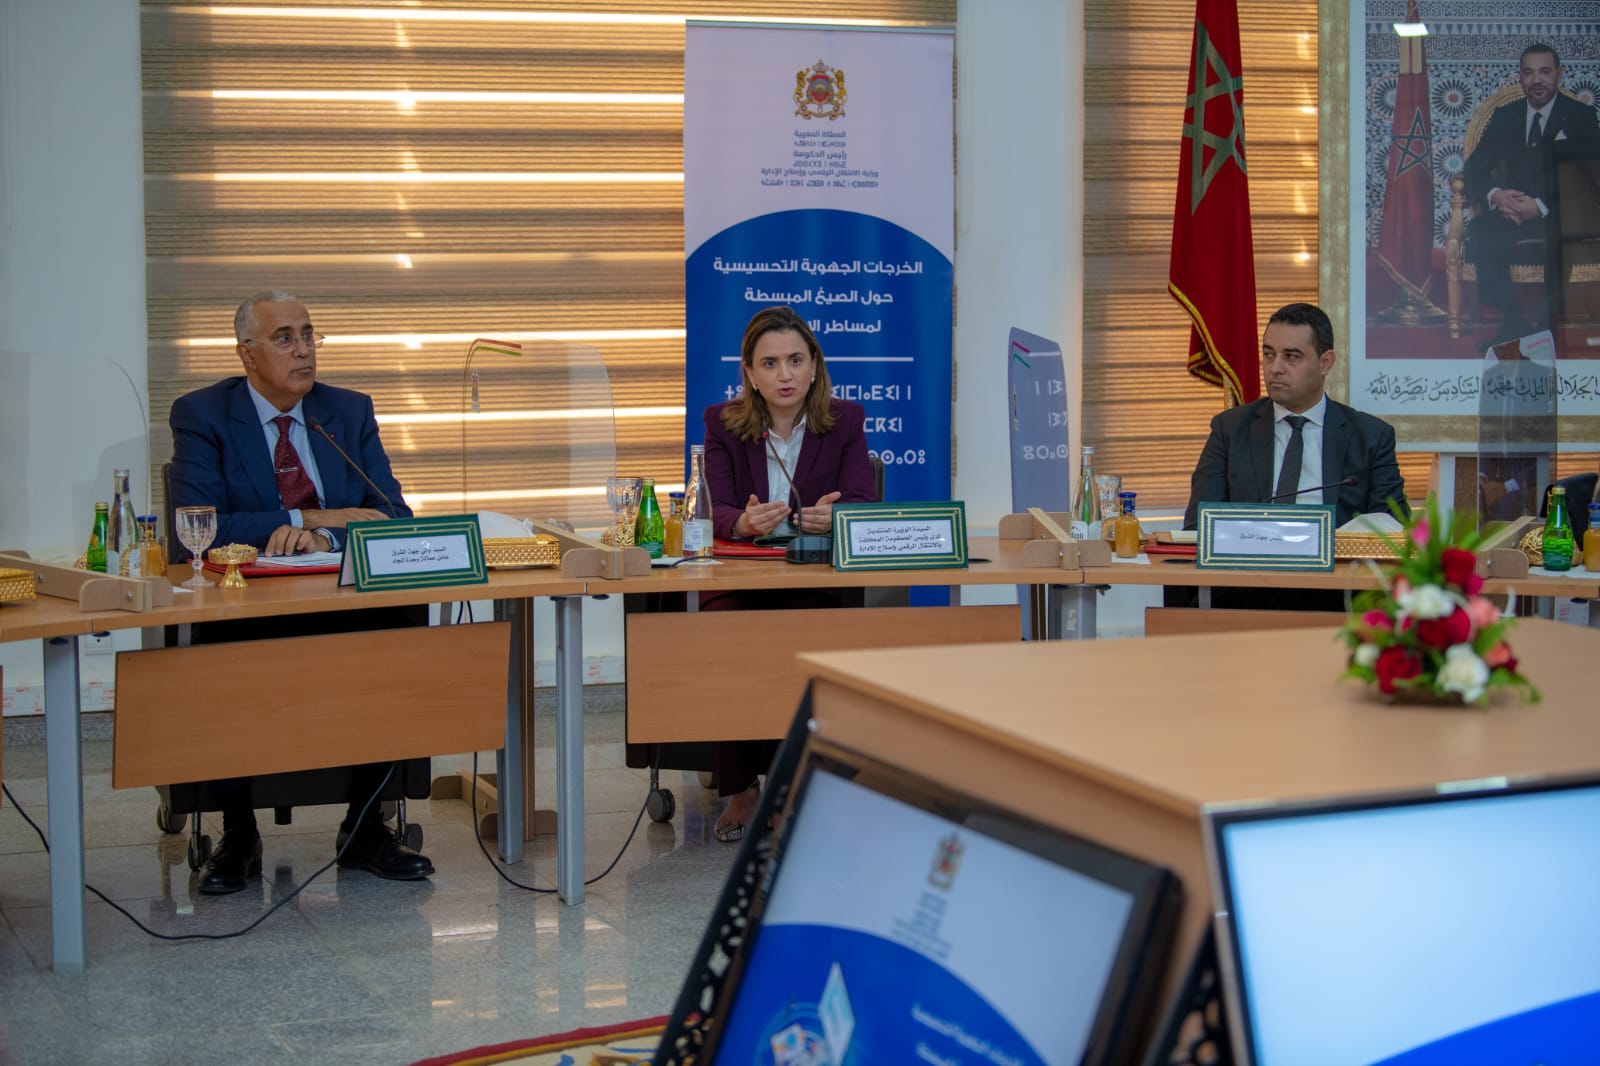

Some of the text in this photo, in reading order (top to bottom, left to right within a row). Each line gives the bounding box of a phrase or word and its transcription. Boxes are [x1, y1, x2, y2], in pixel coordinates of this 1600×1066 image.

[793, 150, 825, 159] الحكومة
[713, 257, 923, 277] الخرجات الجهوية التحسيسية
[744, 287, 893, 306] حول الصيغ المبسطة
[824, 319, 882, 334] لمساطر
